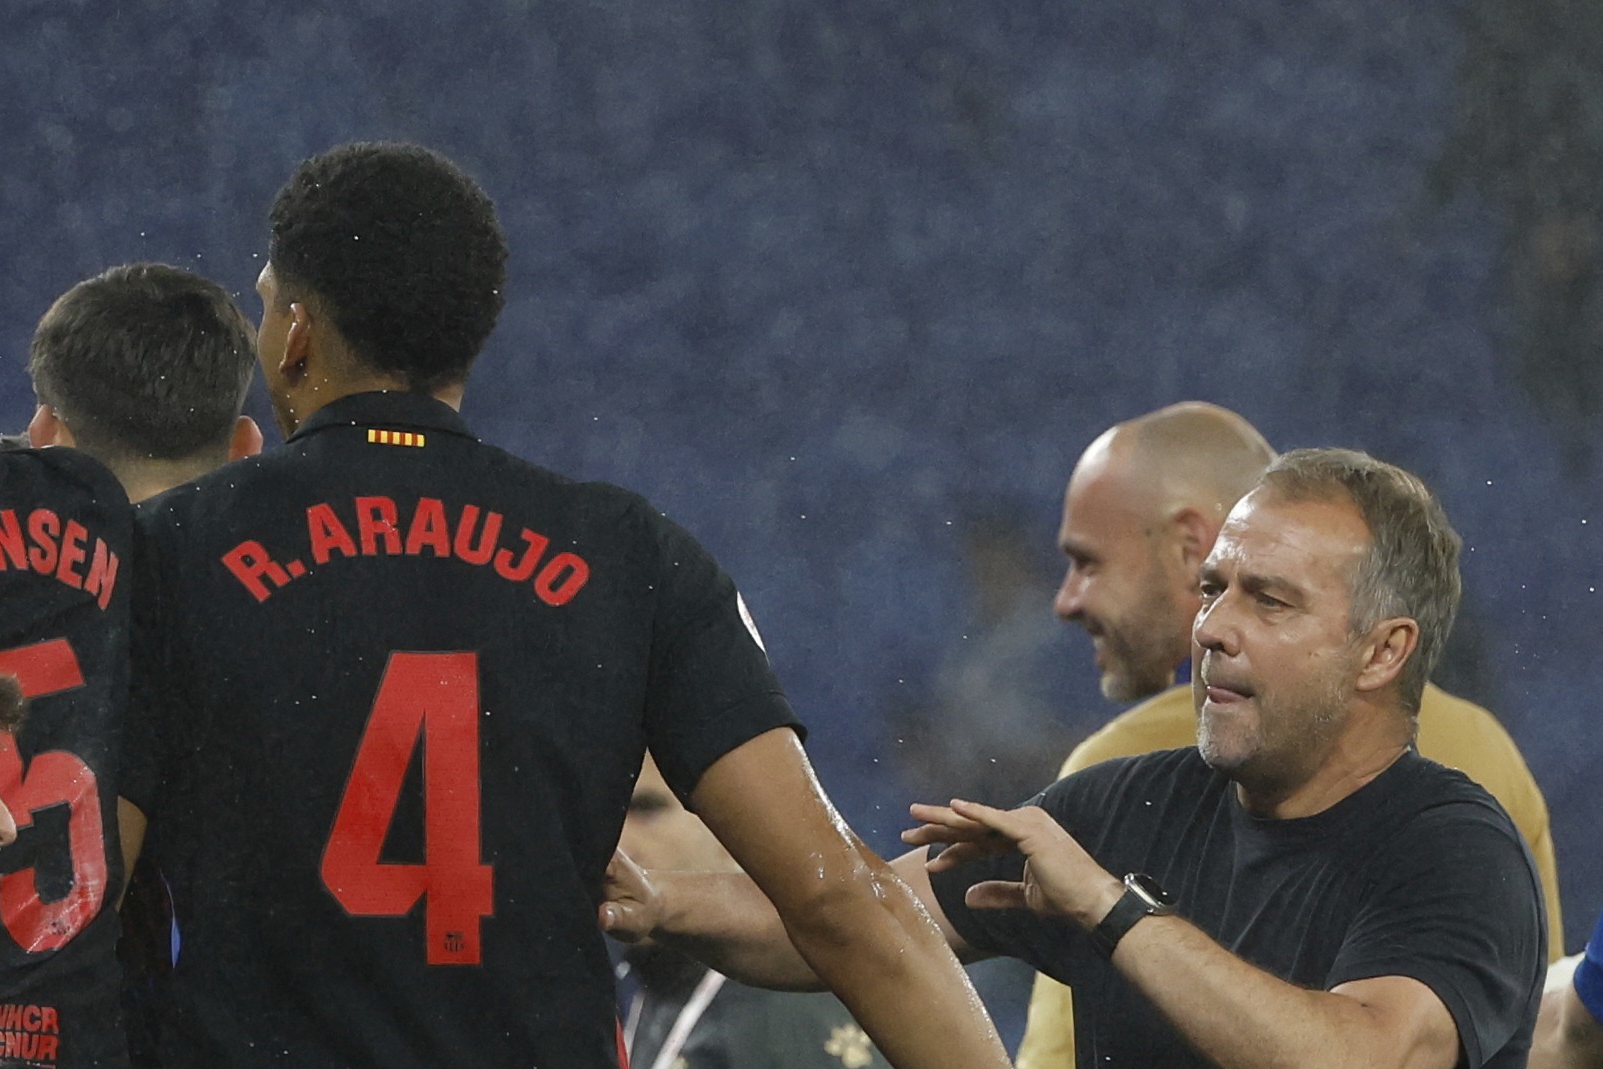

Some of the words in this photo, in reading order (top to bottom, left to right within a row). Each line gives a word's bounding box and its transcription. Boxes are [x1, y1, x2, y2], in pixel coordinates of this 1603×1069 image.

[221, 540, 305, 602] R.
[307, 496, 590, 606] ARAUJO
[320, 652, 493, 965] 4
